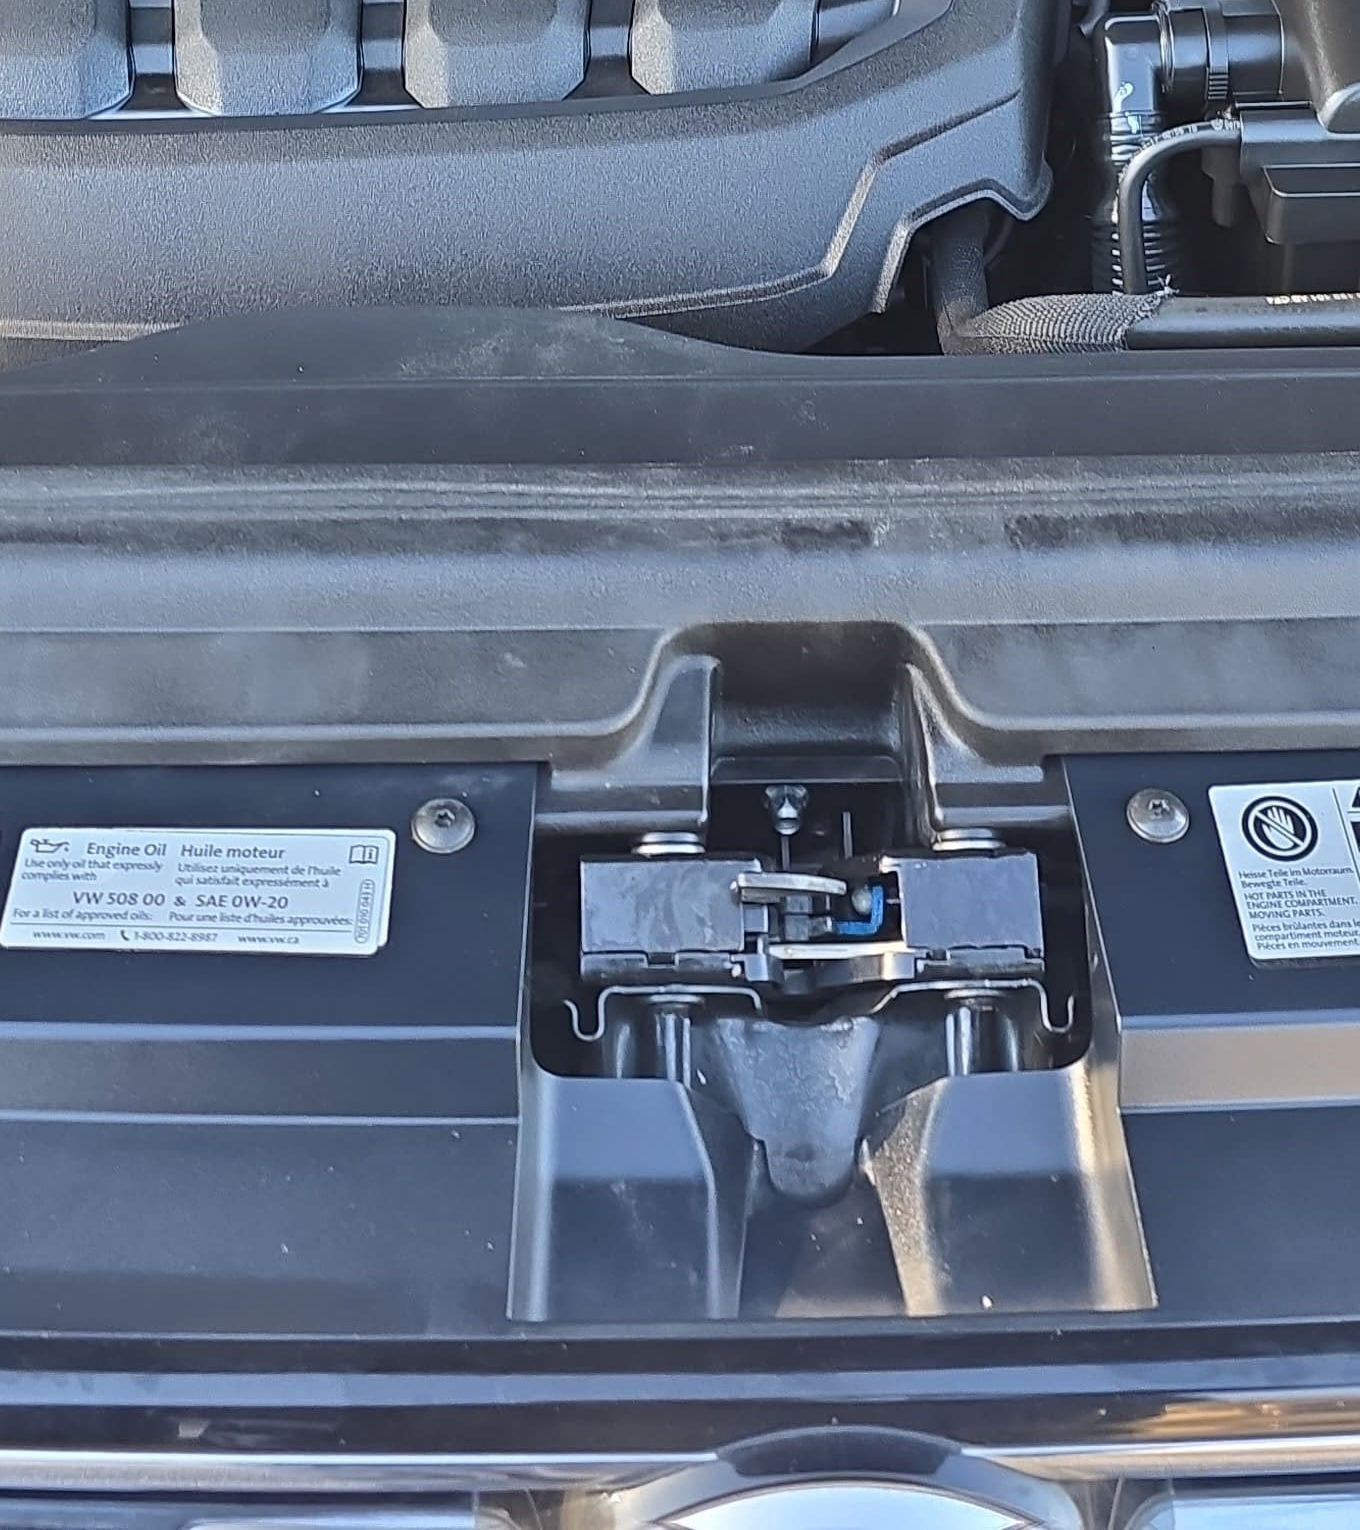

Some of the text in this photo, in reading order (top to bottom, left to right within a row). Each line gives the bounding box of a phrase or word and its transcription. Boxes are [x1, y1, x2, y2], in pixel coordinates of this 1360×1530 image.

[86, 842, 286, 859] Engine Oil Huile moteur
[72, 892, 289, 910] VW 508 00 & SAE 0W-20
